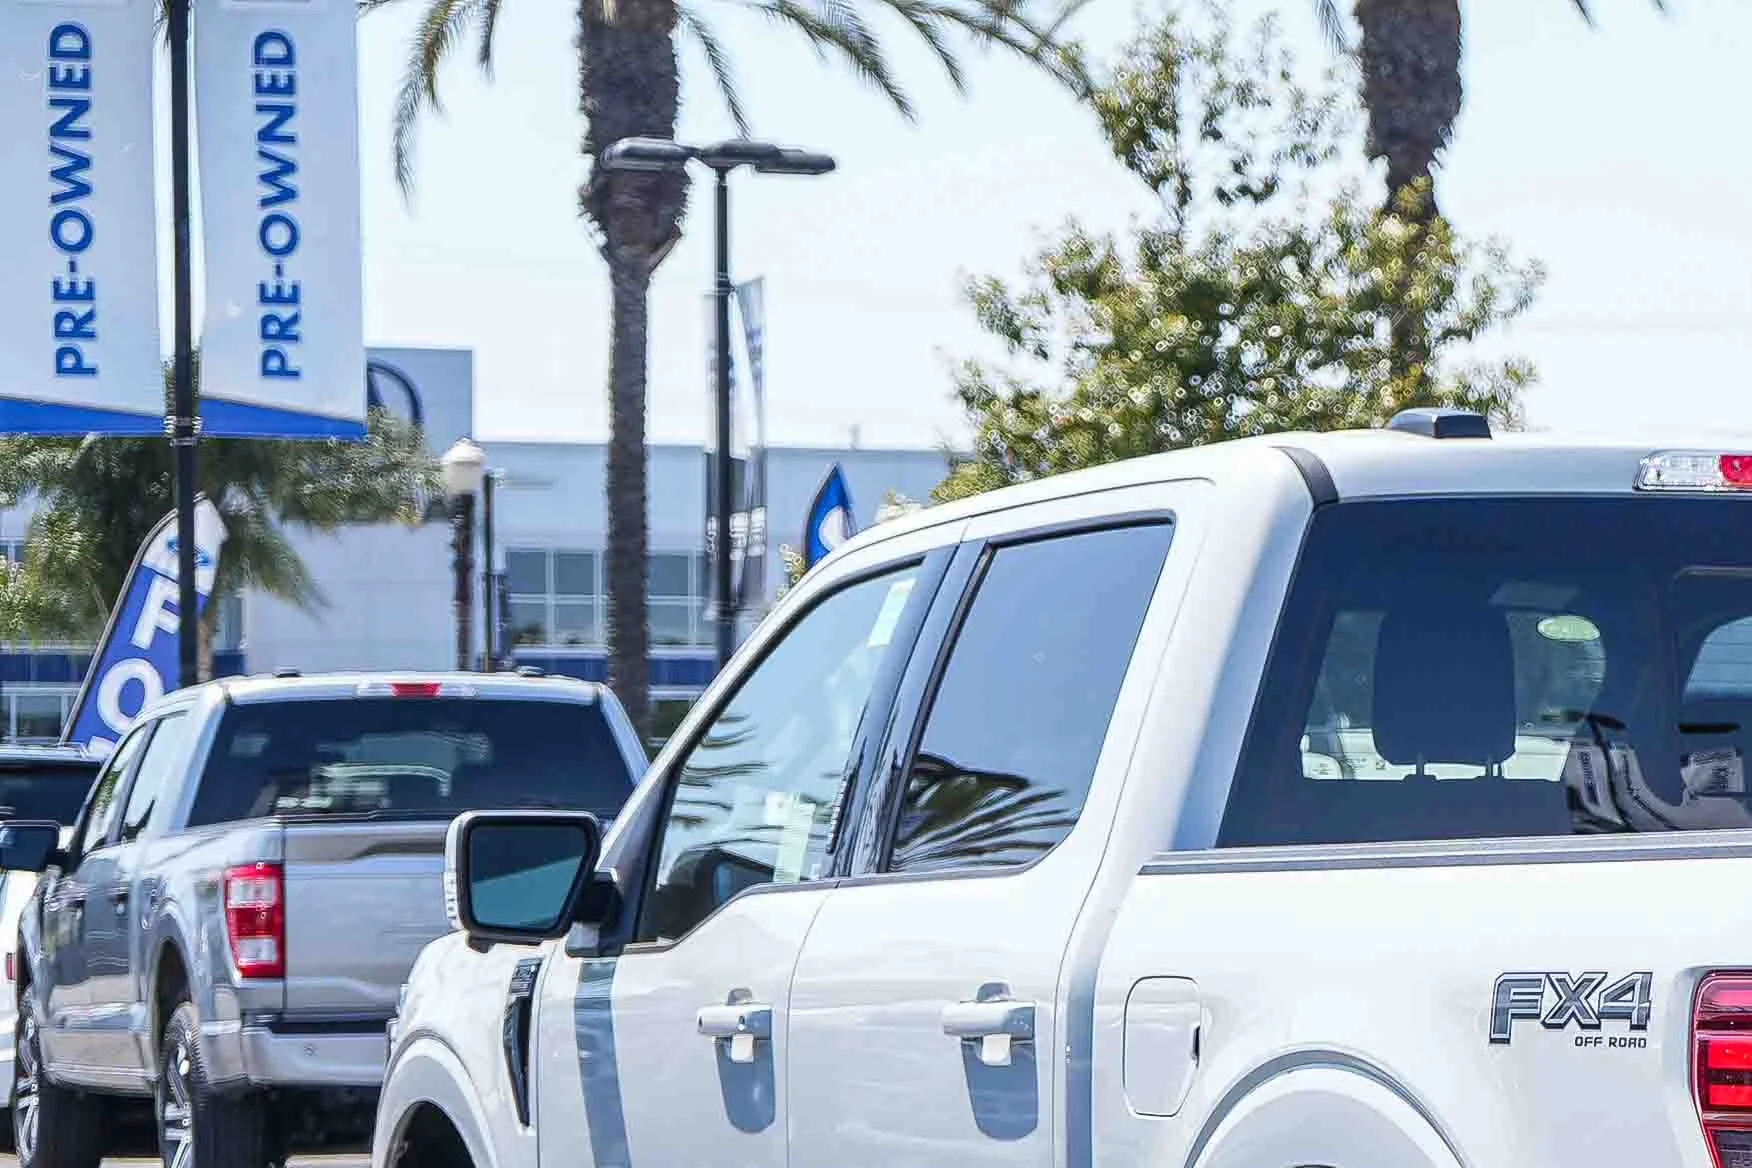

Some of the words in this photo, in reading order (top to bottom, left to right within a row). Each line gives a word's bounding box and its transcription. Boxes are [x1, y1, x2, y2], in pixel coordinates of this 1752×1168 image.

[47, 20, 99, 379] PRE-OWNED
[253, 28, 302, 381] PRE-OWNED
[97, 573, 181, 755] FO
[1489, 971, 1653, 1044] FX4
[1574, 1036, 1604, 1048] OFF
[1608, 1036, 1648, 1049] ROAD
